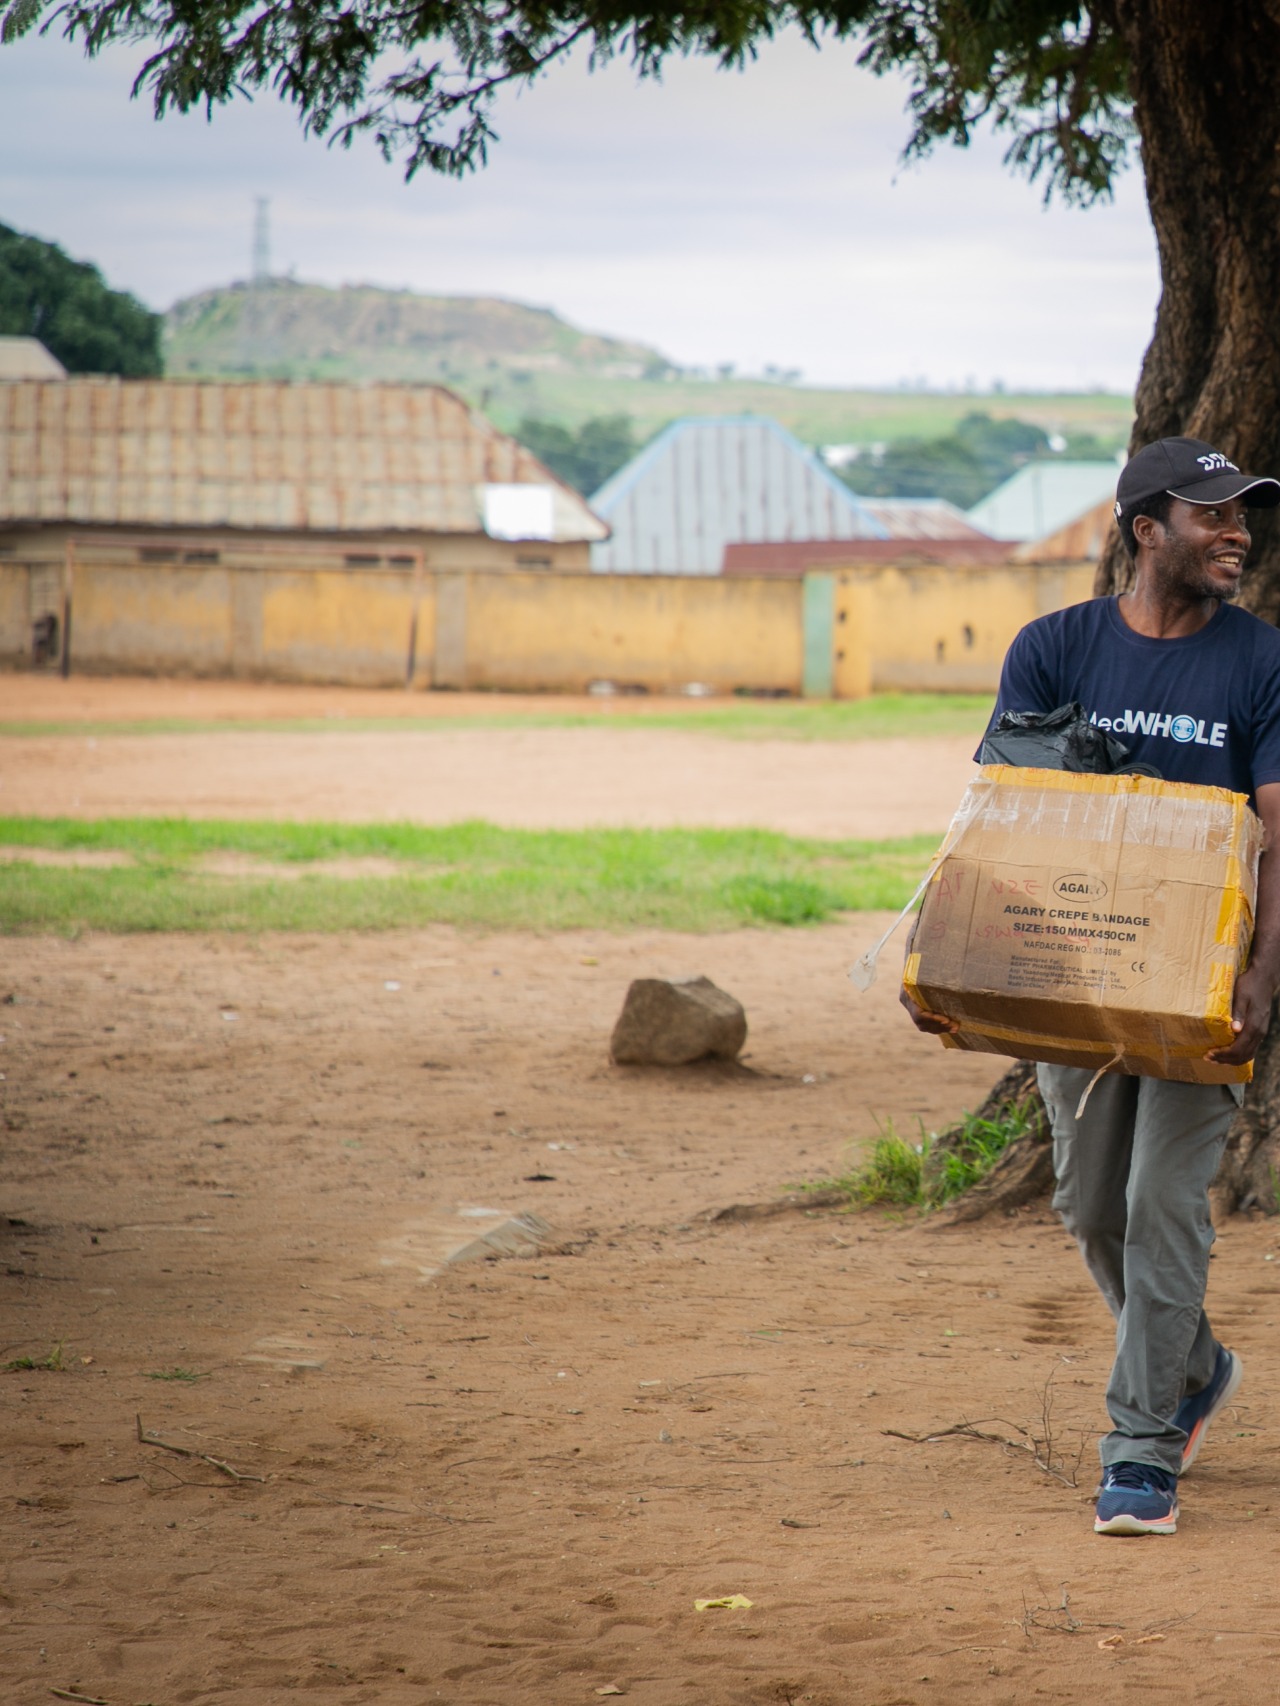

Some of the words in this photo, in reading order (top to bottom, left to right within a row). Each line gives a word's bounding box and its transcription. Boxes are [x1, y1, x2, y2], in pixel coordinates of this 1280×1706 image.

[1004, 905, 1046, 918] AGARY
[1049, 909, 1088, 921] CREPE
[1092, 913, 1150, 927] BANDAGE
[1024, 941, 1056, 952] NAFDAC
[1058, 943, 1074, 952] REG
